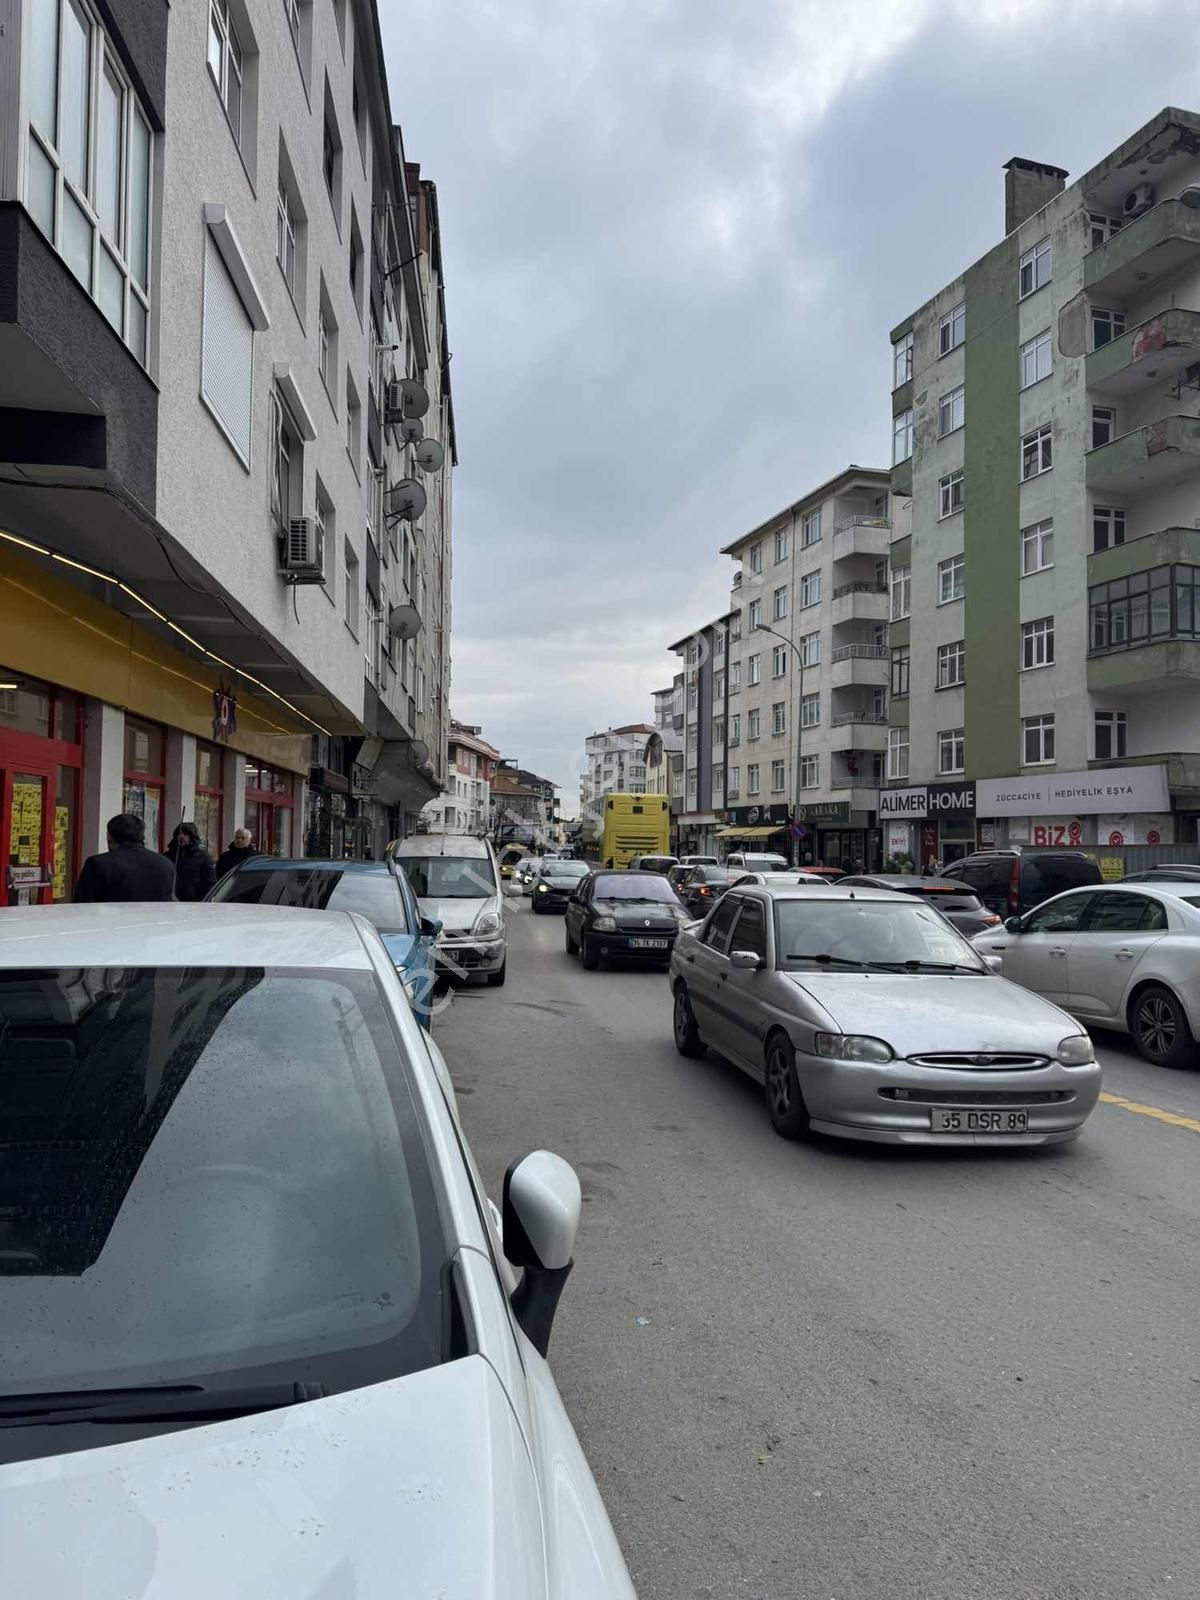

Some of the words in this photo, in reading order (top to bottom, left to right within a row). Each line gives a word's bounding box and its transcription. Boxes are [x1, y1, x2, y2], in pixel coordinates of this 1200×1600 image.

[881, 792, 926, 812] ALİMER
[929, 791, 974, 810] HOME
[941, 1112, 961, 1129] 35
[967, 1112, 1001, 1130] DSR
[1007, 1112, 1026, 1128] 89
